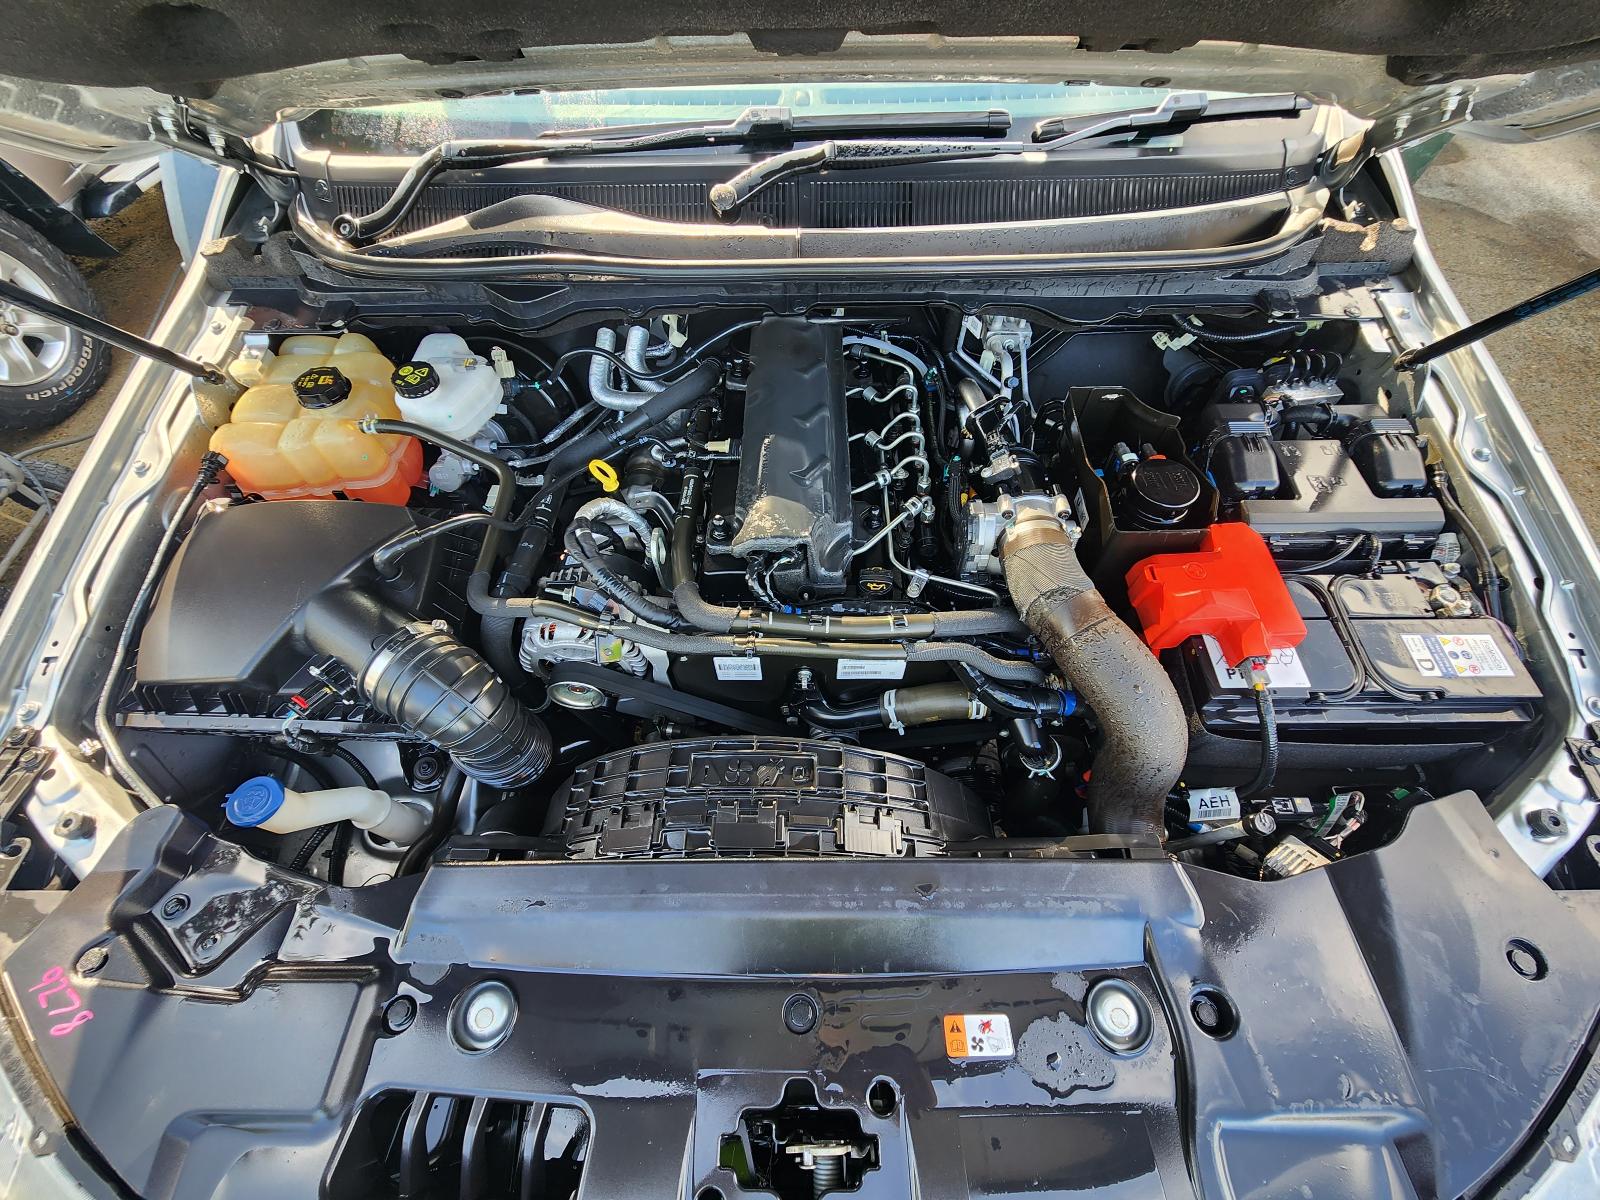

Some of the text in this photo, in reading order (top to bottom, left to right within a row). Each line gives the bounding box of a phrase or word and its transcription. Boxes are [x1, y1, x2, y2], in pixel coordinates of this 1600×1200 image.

[26, 335, 93, 400] FGoodrich
[1198, 794, 1231, 810] AEH
[28, 966, 94, 1035] 9278
